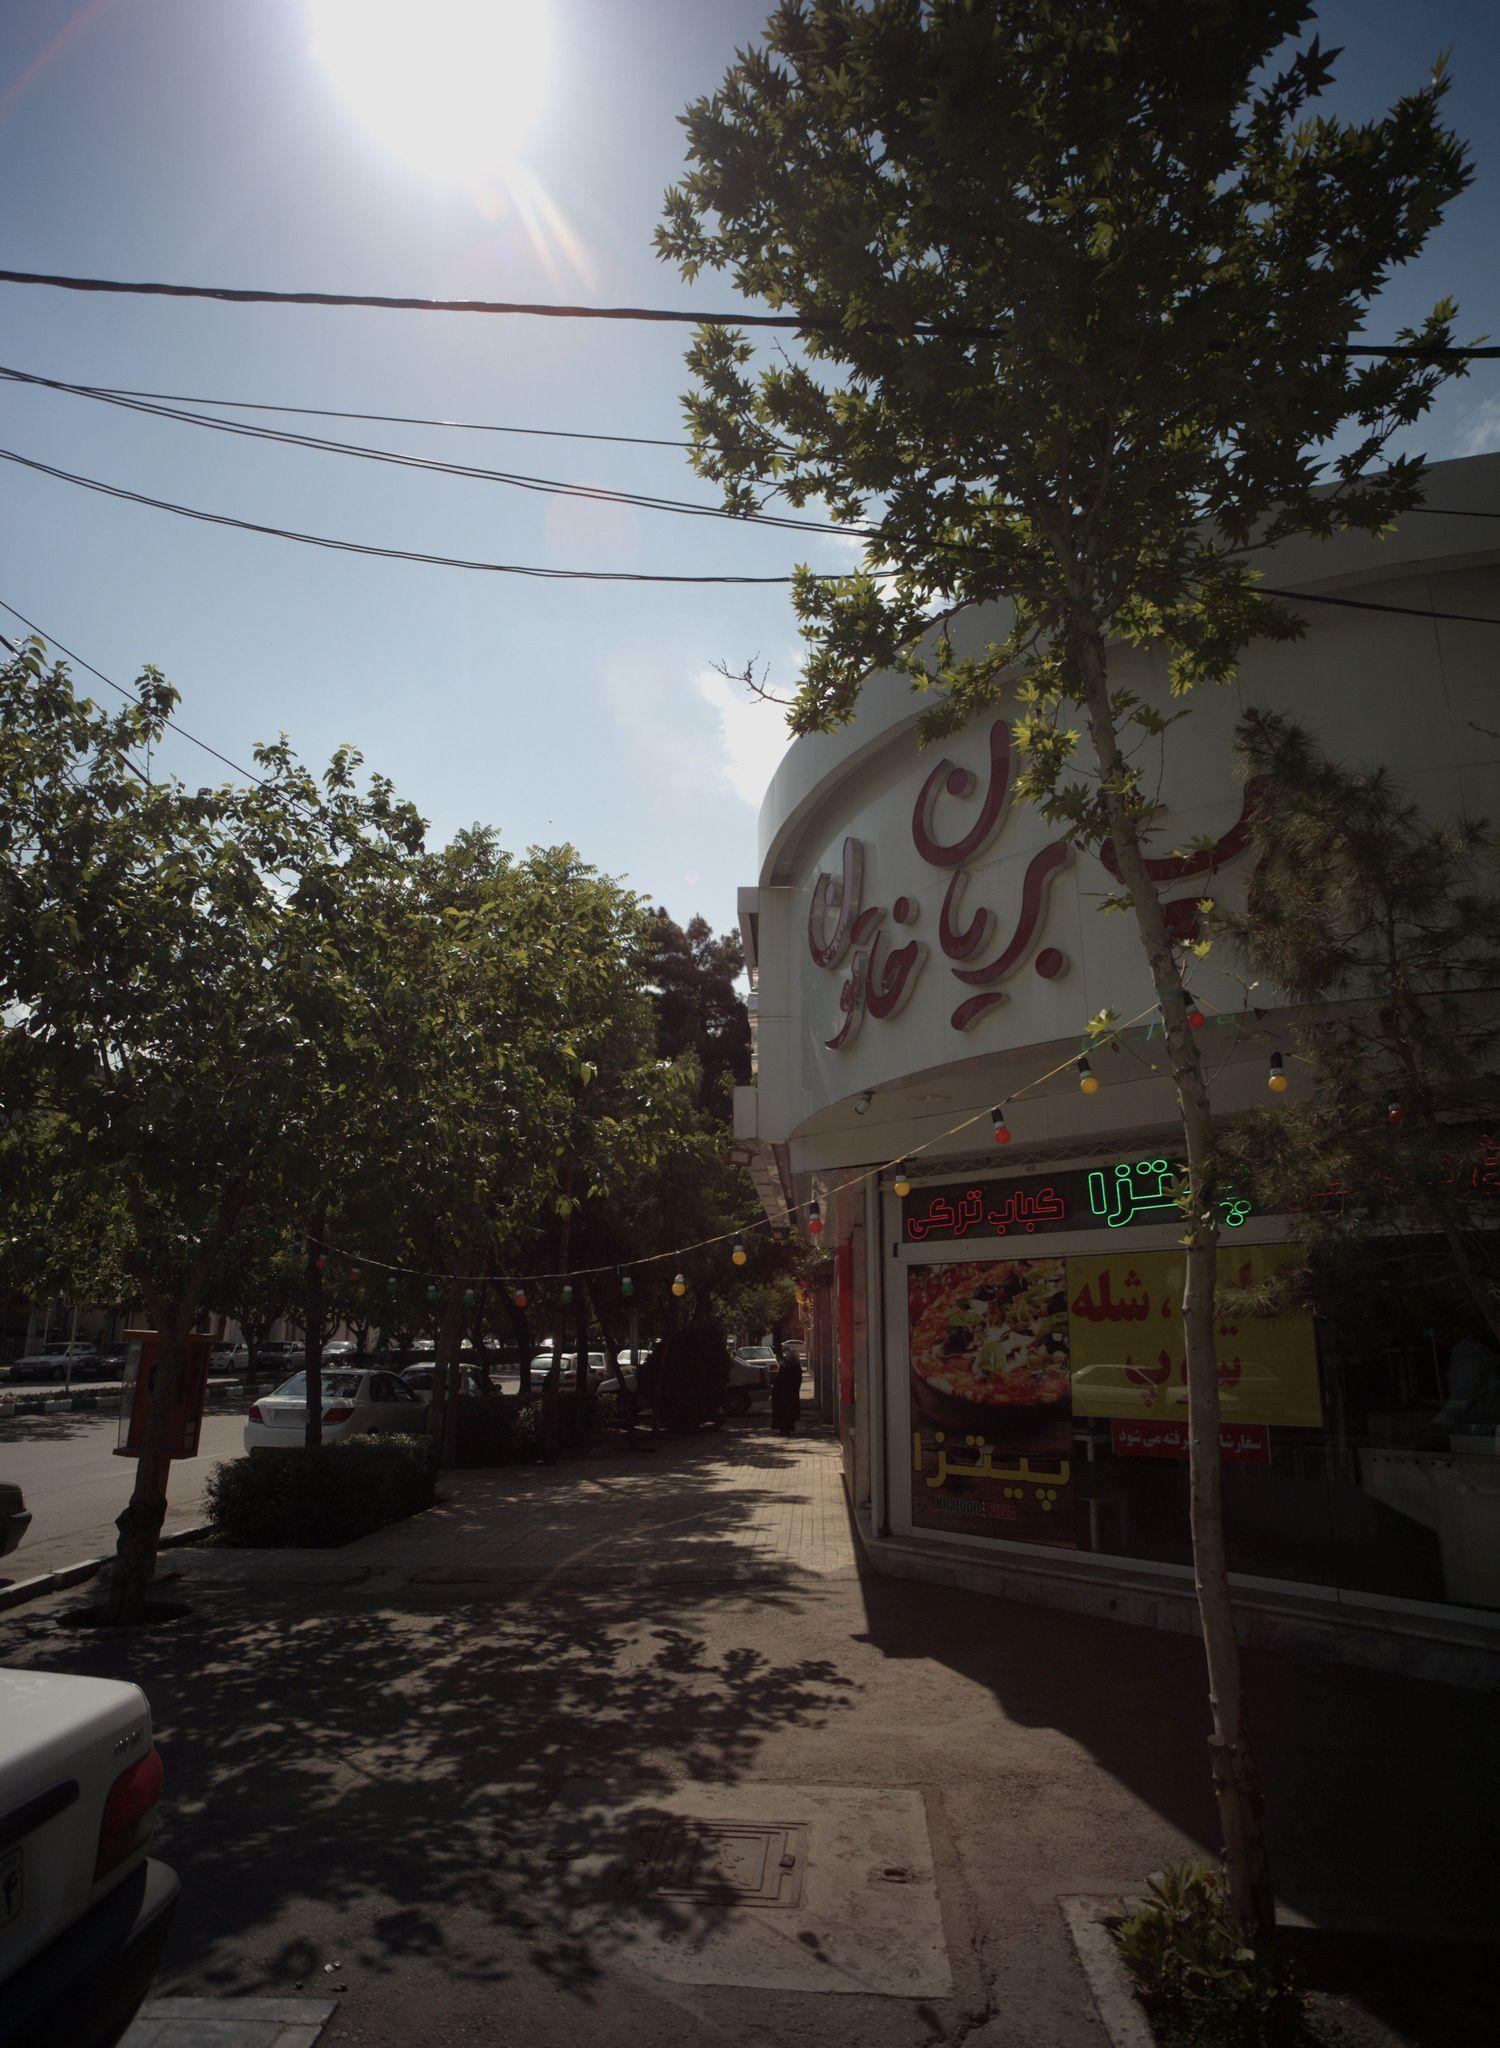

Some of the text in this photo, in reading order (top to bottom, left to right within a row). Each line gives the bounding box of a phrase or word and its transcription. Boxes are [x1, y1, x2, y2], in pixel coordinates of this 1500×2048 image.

[907, 1187, 1064, 1240] کباب ترکی
[1071, 1269, 1149, 1322] شله
[913, 1431, 1071, 1512] پیتزا
